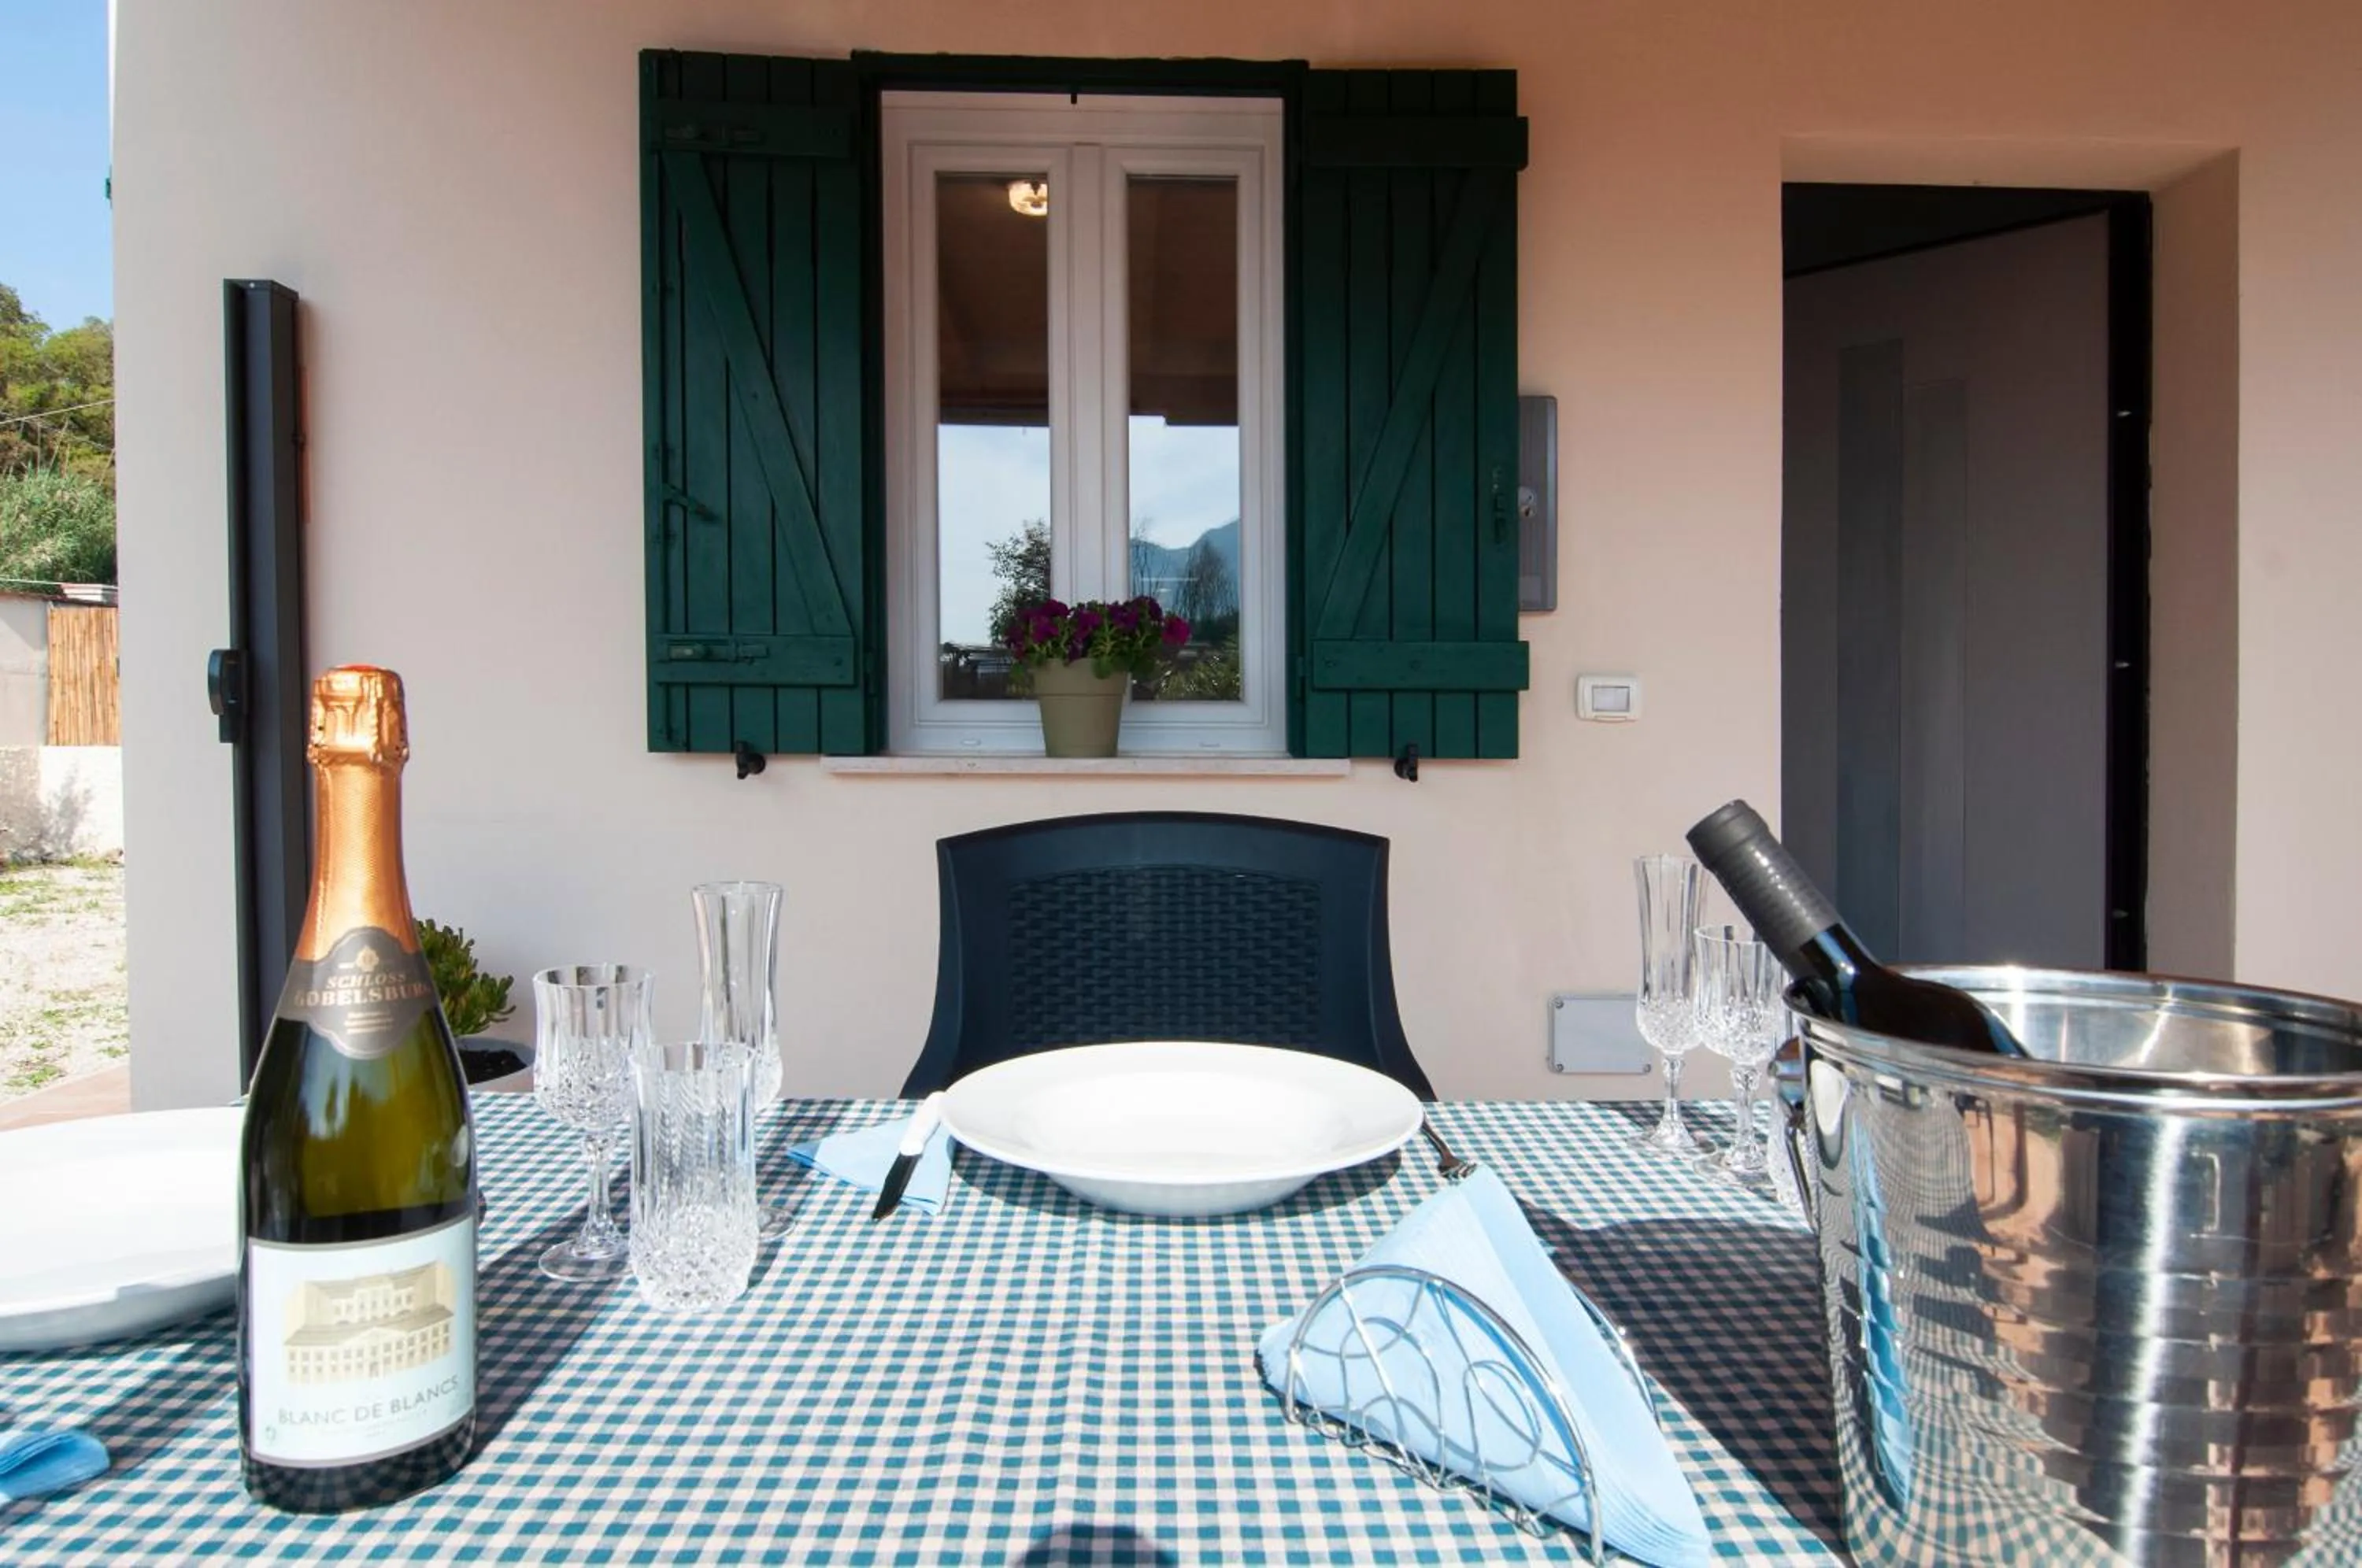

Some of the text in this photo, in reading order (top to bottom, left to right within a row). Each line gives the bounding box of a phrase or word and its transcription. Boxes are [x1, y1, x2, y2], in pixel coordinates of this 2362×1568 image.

[326, 972, 407, 989] SCHLOSS
[278, 1407, 347, 1426] BLANC
[354, 1402, 383, 1422] DE
[390, 1374, 458, 1414] BLANCS
